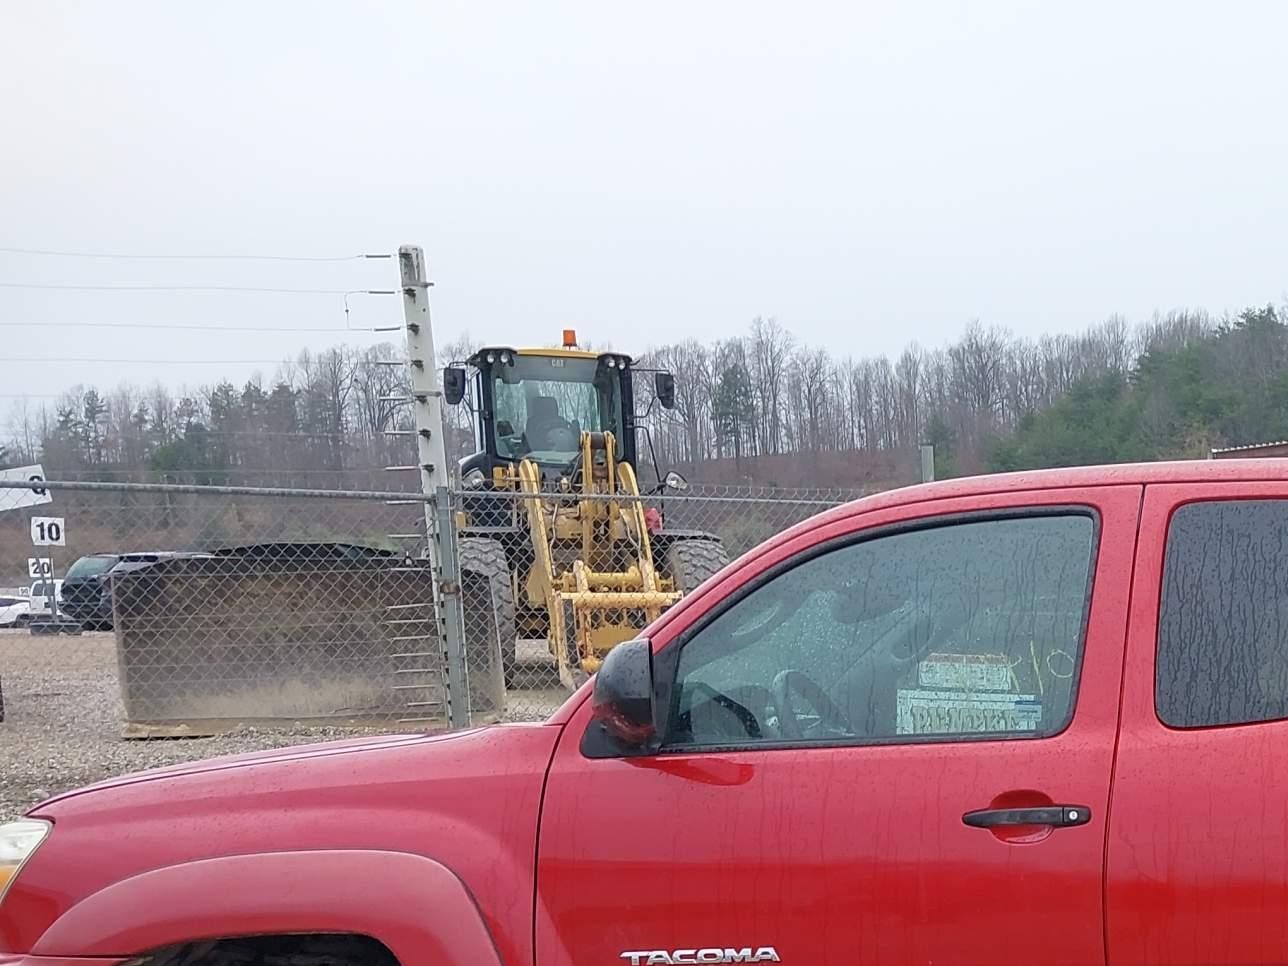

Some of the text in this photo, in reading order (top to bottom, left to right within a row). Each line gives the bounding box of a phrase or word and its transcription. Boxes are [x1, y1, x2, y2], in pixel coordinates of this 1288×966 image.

[36, 522, 60, 541] 10
[31, 562, 50, 574] 20
[620, 946, 781, 966] TACOMA
